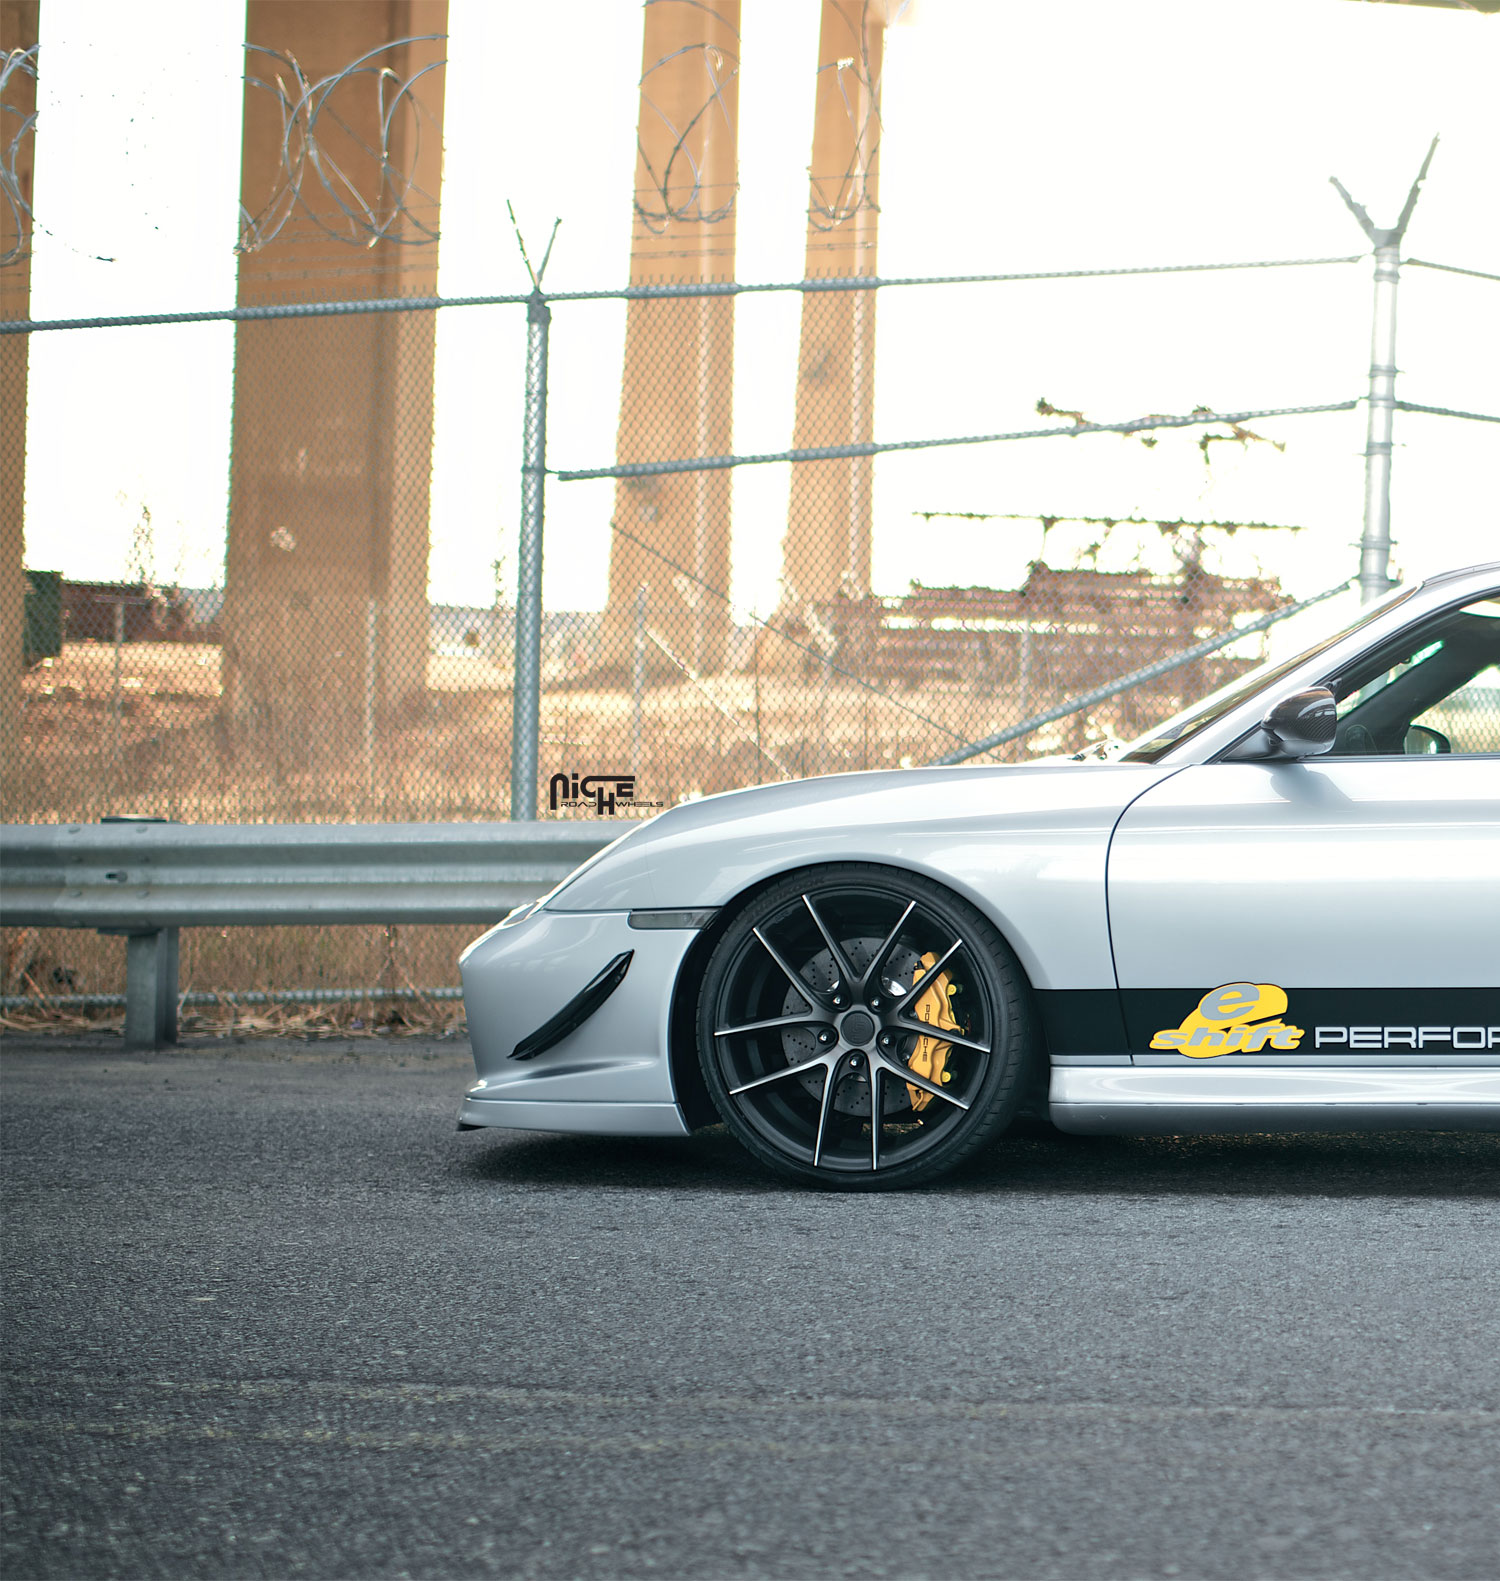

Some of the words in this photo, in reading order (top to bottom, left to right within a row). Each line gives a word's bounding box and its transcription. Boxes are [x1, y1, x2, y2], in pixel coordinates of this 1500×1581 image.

[1199, 983, 1261, 1022] e
[922, 1004, 931, 1062] POCHE
[1151, 1021, 1305, 1051] shift
